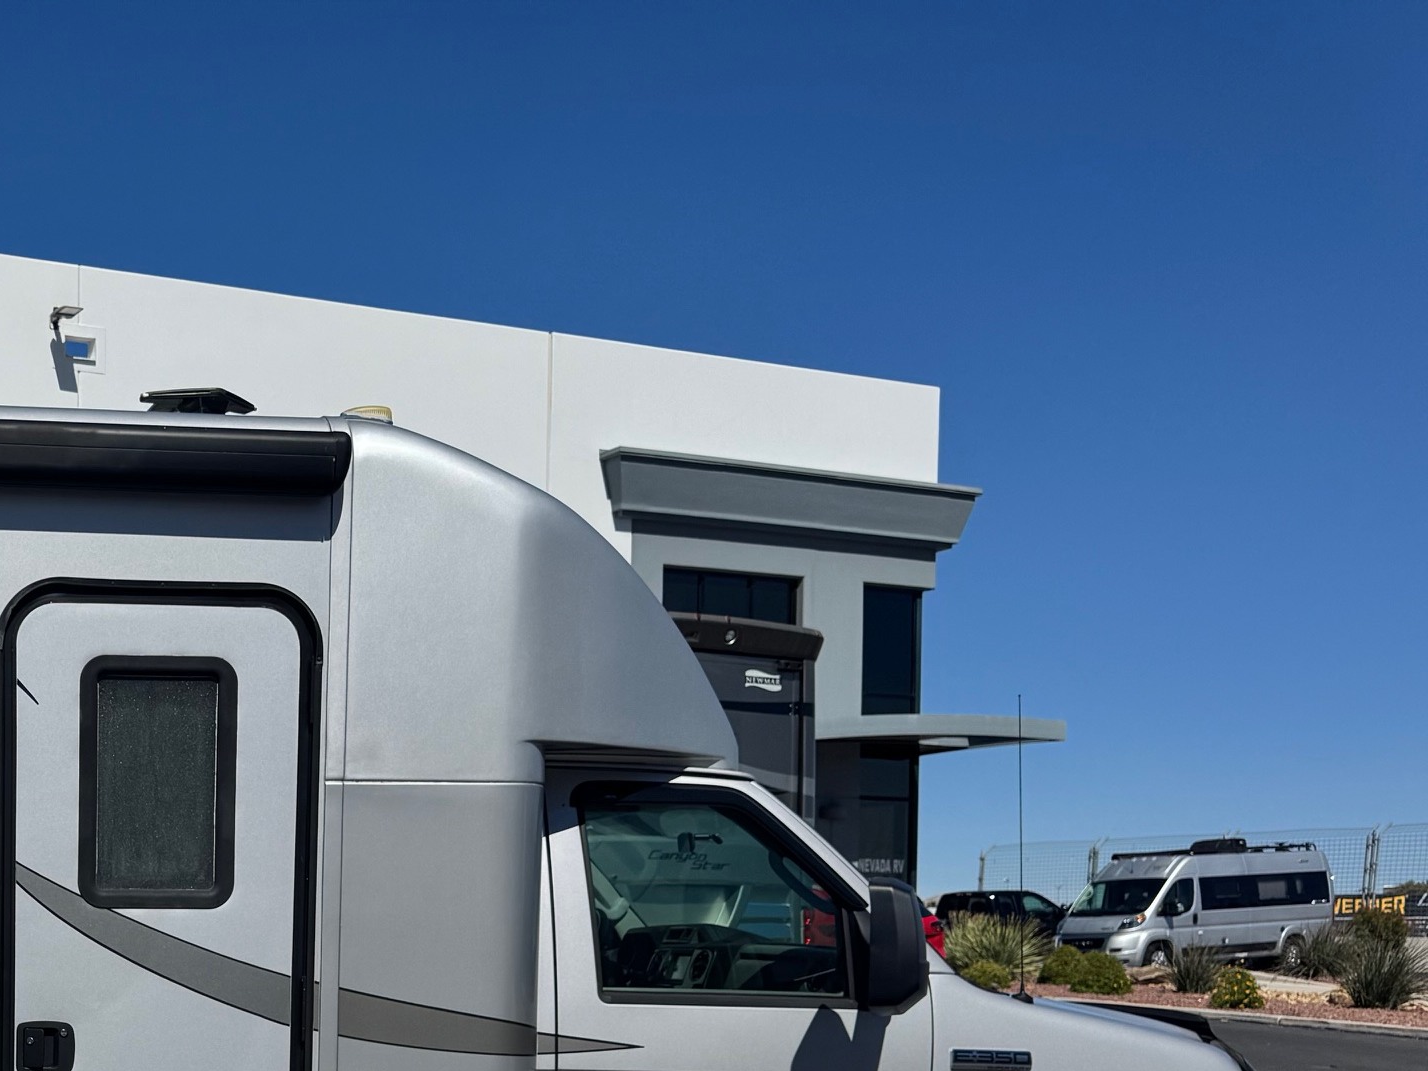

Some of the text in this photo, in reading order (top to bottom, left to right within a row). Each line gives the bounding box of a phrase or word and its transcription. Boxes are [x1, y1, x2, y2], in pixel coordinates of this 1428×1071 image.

[691, 861, 731, 870] Star
[858, 859, 905, 873] NEVADA RV
